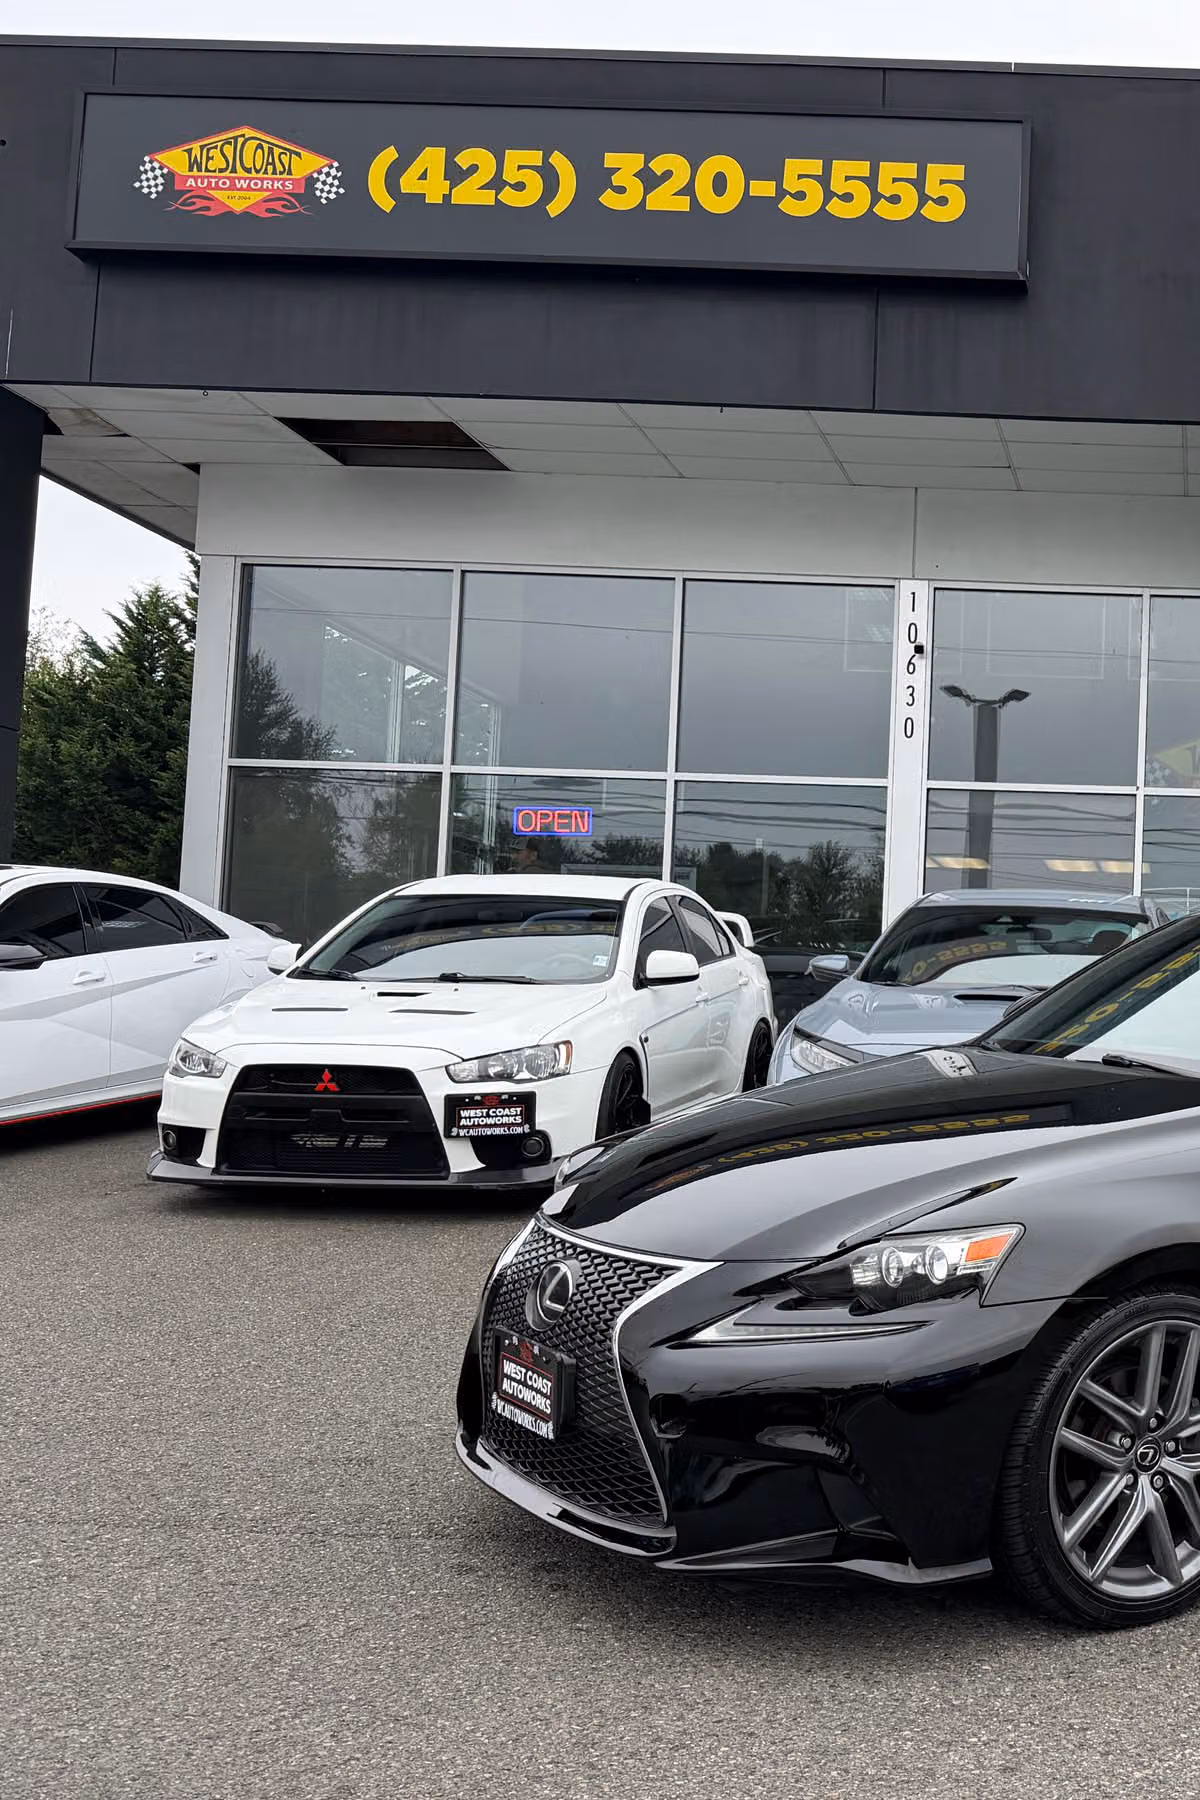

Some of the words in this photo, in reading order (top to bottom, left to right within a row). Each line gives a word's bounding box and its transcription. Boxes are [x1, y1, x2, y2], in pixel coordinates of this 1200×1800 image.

[186, 178, 230, 189] AUTO
[235, 178, 293, 190] WORKS
[367, 144, 577, 218] (425)
[598, 151, 967, 223] 320-5555
[518, 809, 589, 832] OPEN
[460, 1108, 488, 1118] WEST
[489, 1107, 522, 1116] COAST
[460, 1116, 522, 1126] AUTOWORKS
[458, 1126, 524, 1137] WCAUTOWORKS.COM
[503, 1359, 526, 1382] WEST
[526, 1370, 552, 1396] COAST
[502, 1378, 552, 1414] AUTOWORKS
[497, 1398, 548, 1439] WCAUTOWORKS.COM
